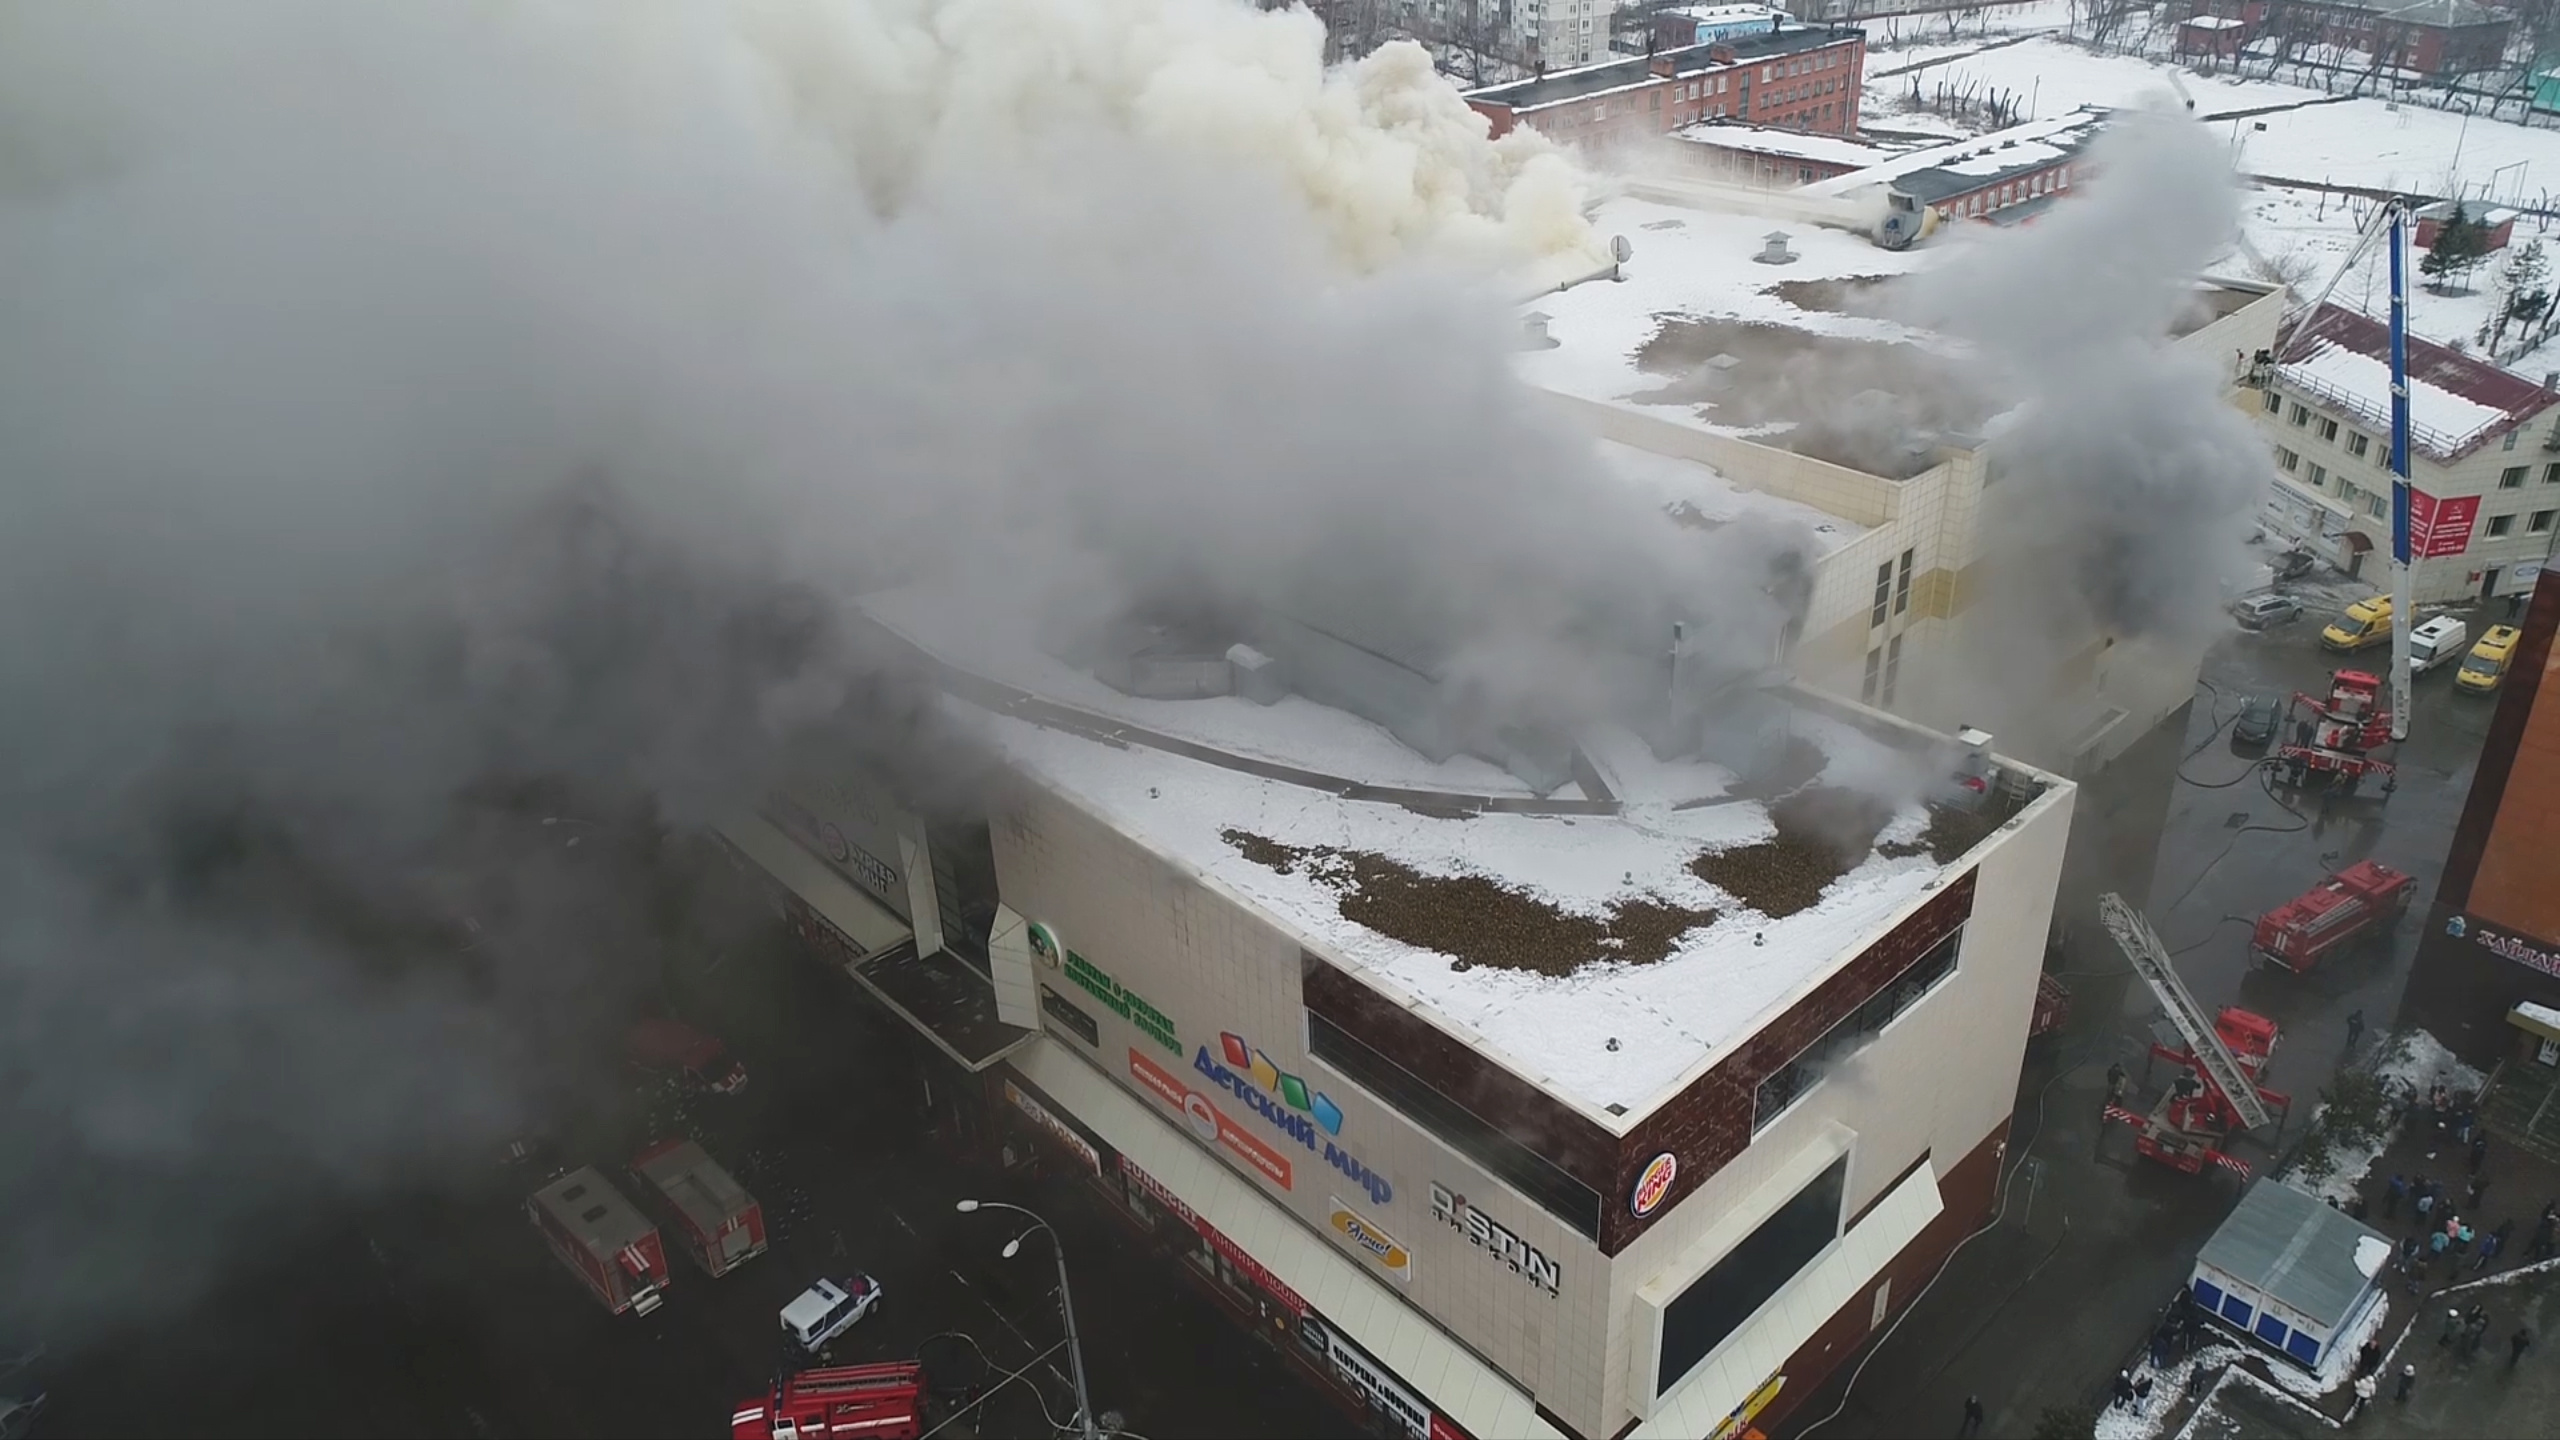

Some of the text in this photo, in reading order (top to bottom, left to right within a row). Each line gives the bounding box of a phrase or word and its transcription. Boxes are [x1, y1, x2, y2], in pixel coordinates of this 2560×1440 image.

[1122, 1156, 1198, 1223] SUNLIGHT
[1636, 1156, 1672, 1201] BURGER
[1637, 1169, 1672, 1213] KING
[1430, 1180, 1560, 1289] O'STIN
